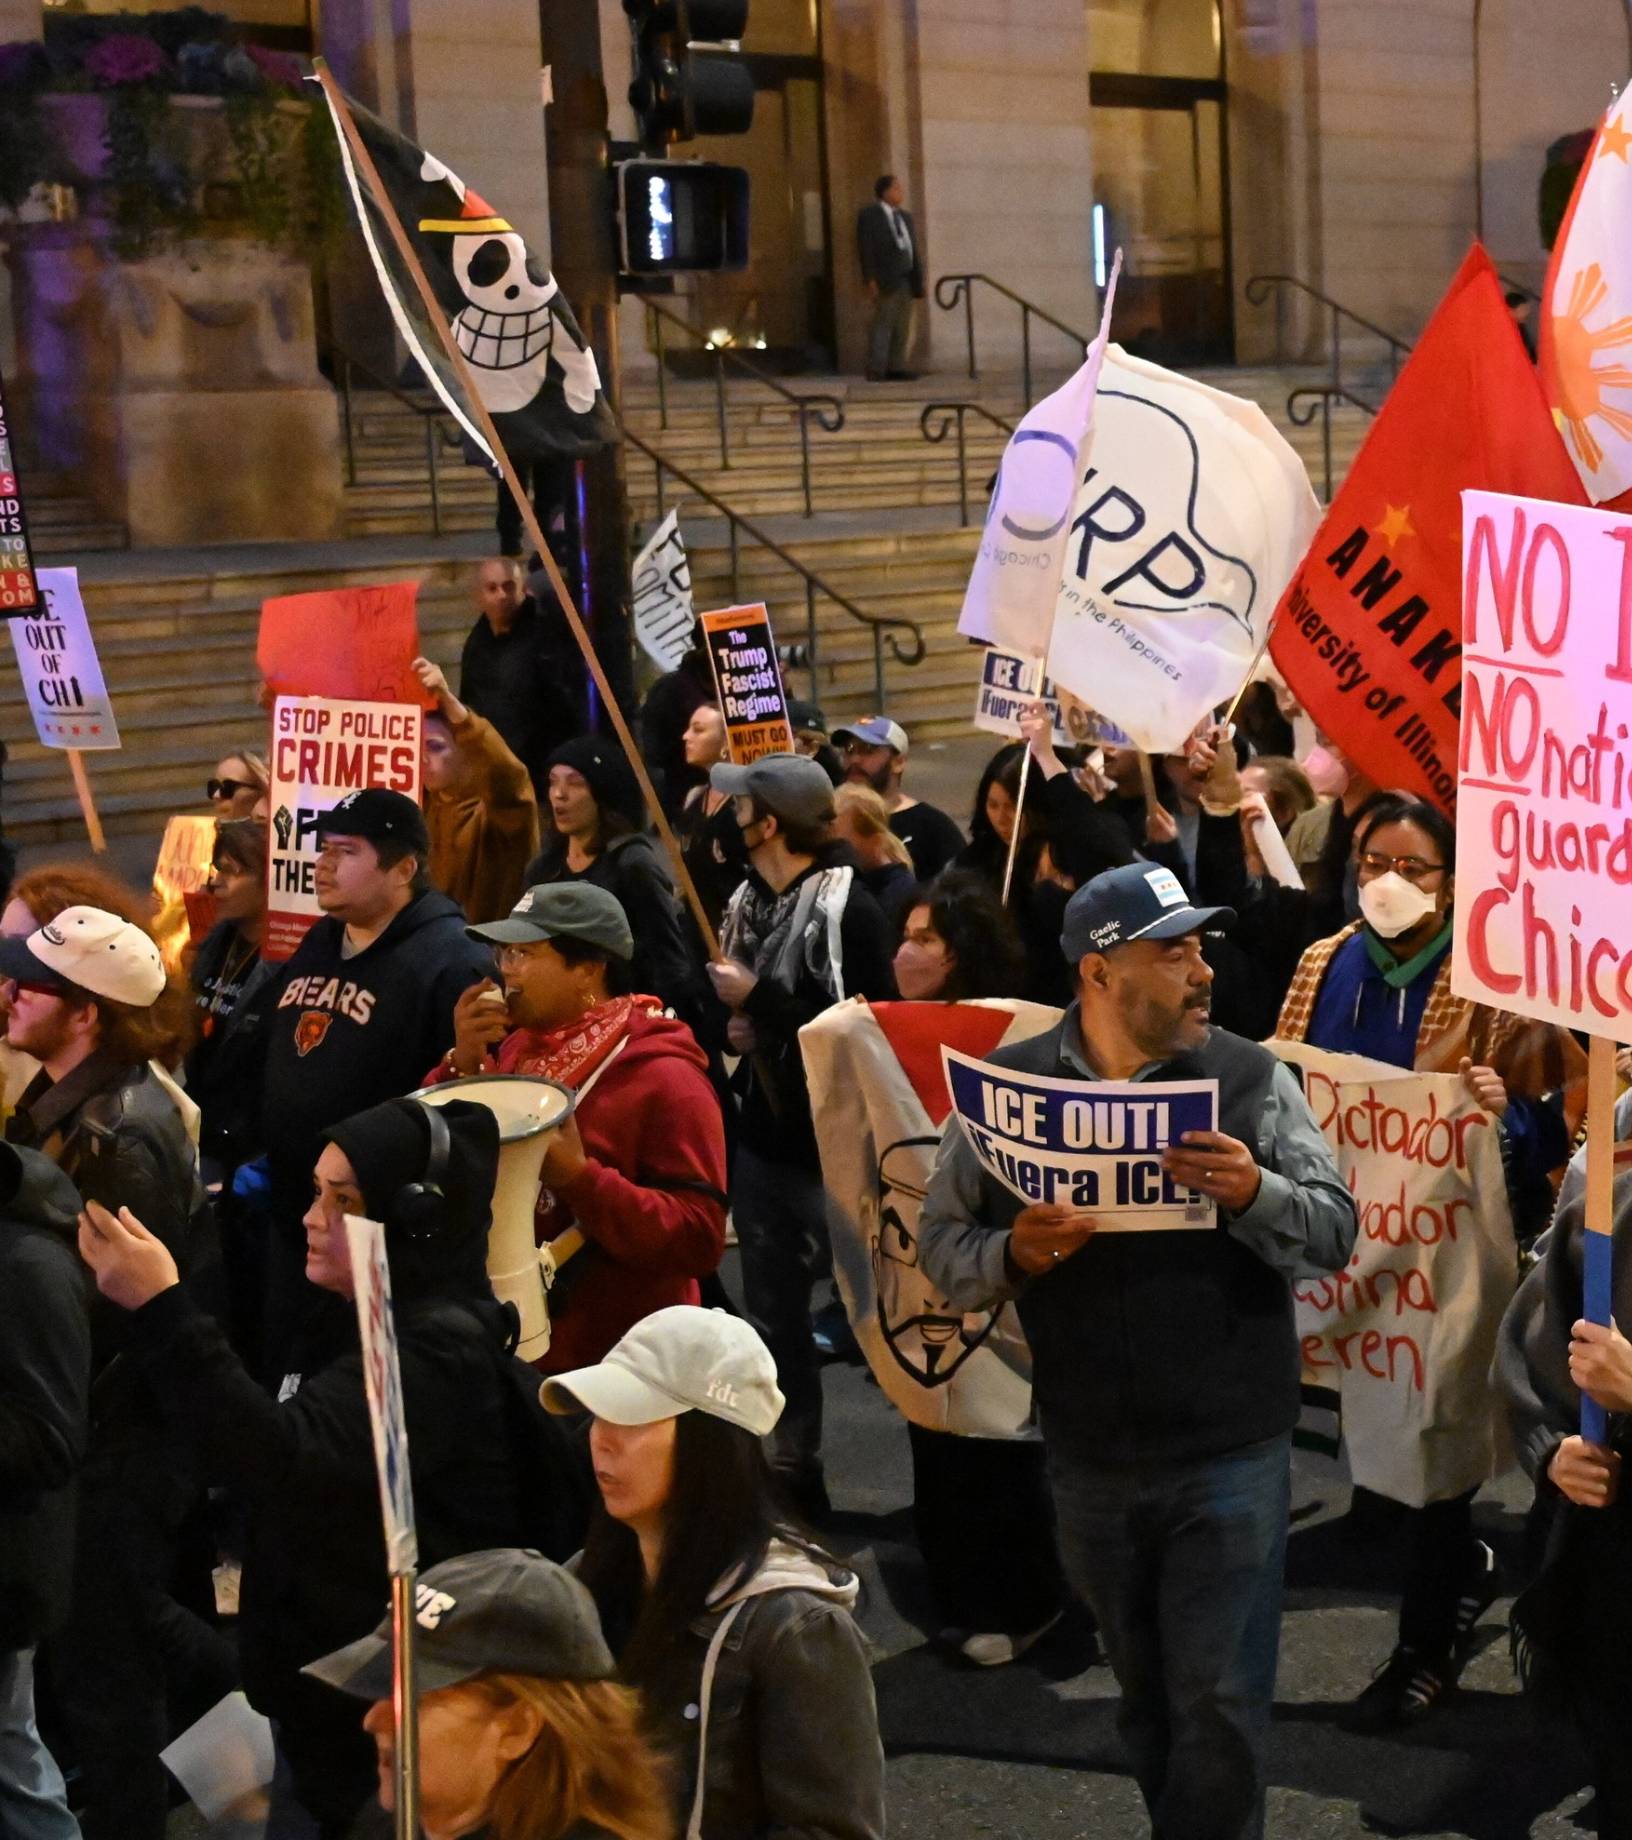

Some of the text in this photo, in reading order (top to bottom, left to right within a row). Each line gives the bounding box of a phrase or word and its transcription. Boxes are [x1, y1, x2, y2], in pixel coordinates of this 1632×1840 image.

[1464, 507, 1572, 658] NO
[25, 624, 67, 651] OUT
[728, 630, 747, 644] The
[1080, 598, 1107, 624] the
[1107, 618, 1183, 682] Philippines
[41, 653, 62, 674] OF
[719, 646, 768, 671] Trump
[722, 669, 776, 694] Fascist
[726, 692, 781, 721] Regime
[1364, 687, 1407, 720] of
[279, 707, 415, 741] STOP POLICE
[732, 726, 787, 747] MUST GO
[1460, 671, 1540, 782] NO
[276, 738, 414, 792] CRIMES
[1090, 919, 1121, 941] Gaelic
[1096, 932, 1121, 949] Park
[278, 975, 376, 1025] BEARS
[981, 1080, 1170, 1150] ICE OUT!
[1307, 1071, 1488, 1170] Dictador
[967, 1122, 1099, 1207] ¡Fuera
[1301, 1329, 1424, 1392] eren
